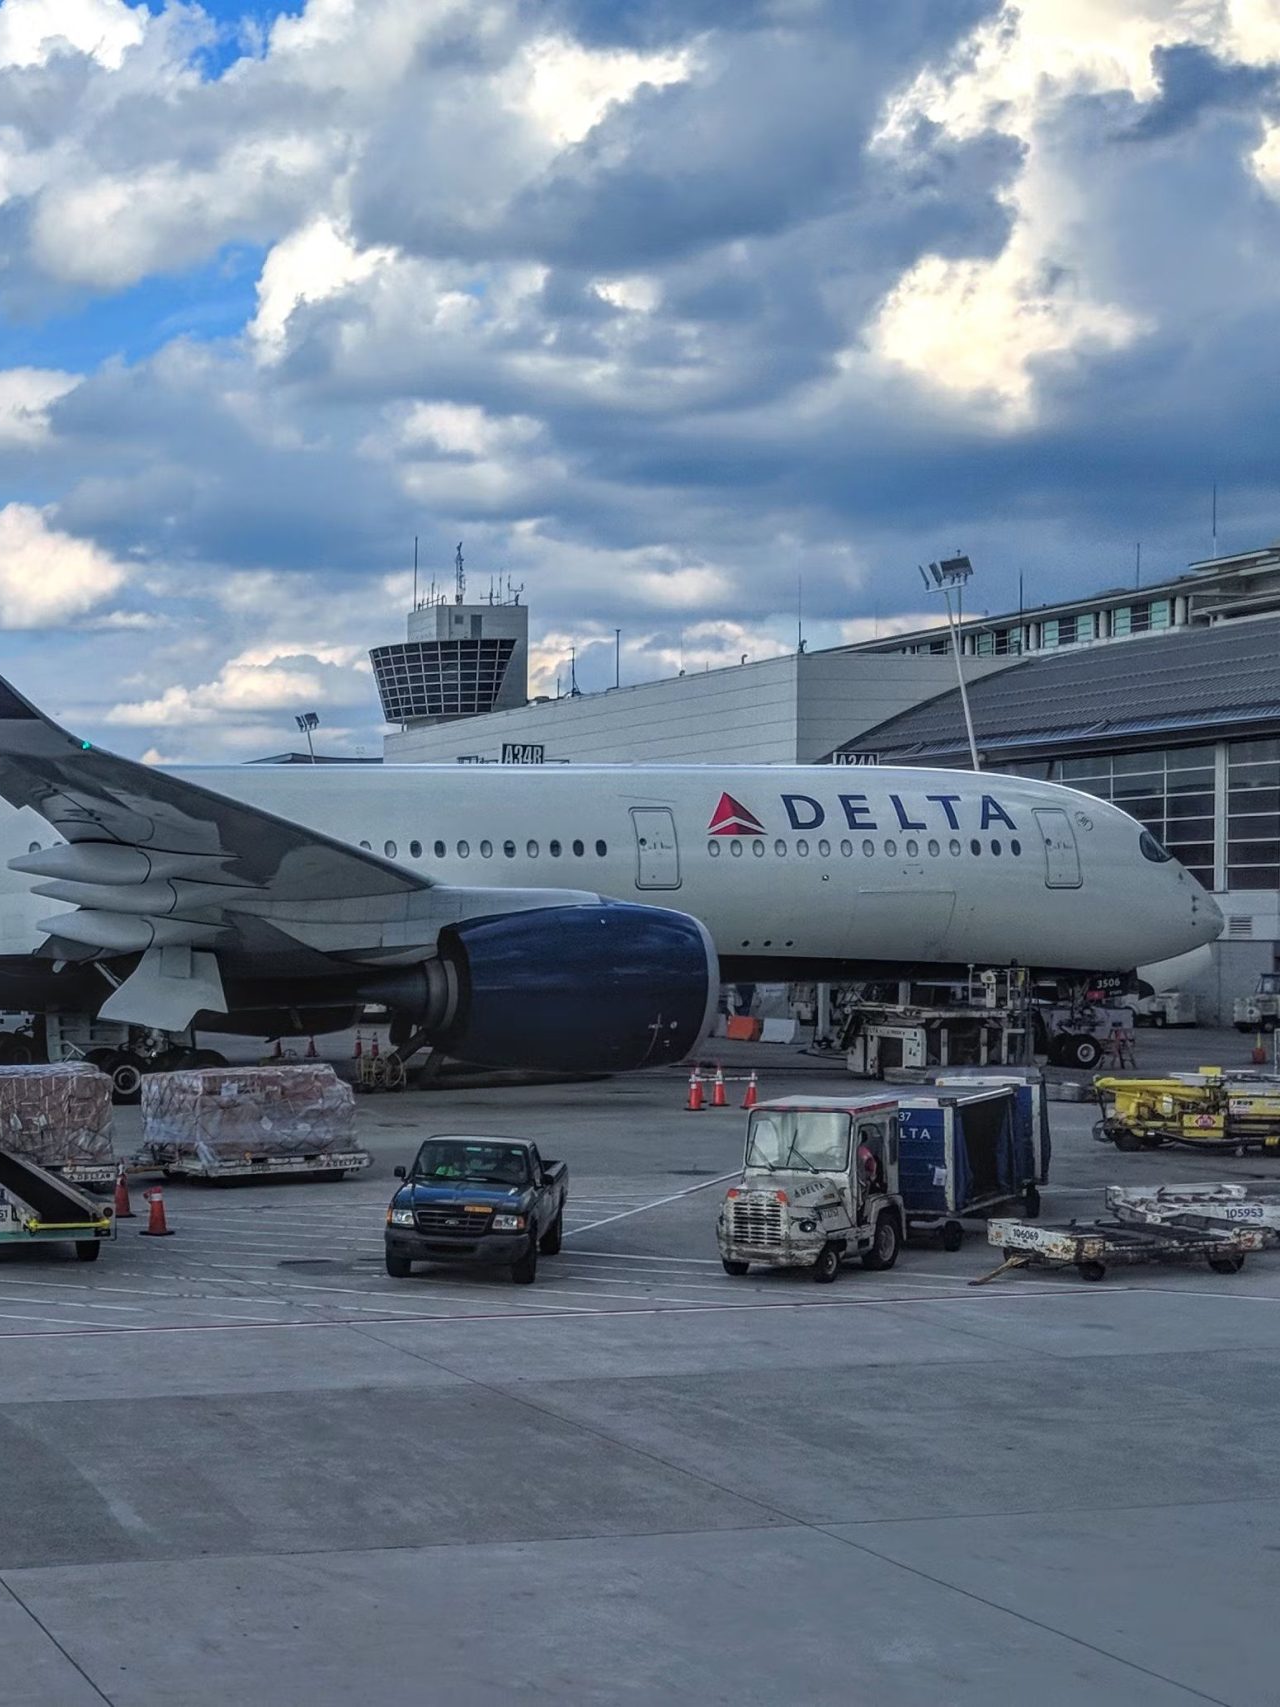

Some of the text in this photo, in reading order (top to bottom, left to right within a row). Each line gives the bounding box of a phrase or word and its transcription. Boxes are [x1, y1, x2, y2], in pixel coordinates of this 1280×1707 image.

[780, 794, 1017, 831] DELTA
[1096, 978, 1120, 989] 3506
[900, 1128, 931, 1139] LTA
[800, 1183, 825, 1195] DELTA
[1226, 1208, 1263, 1218] 105953
